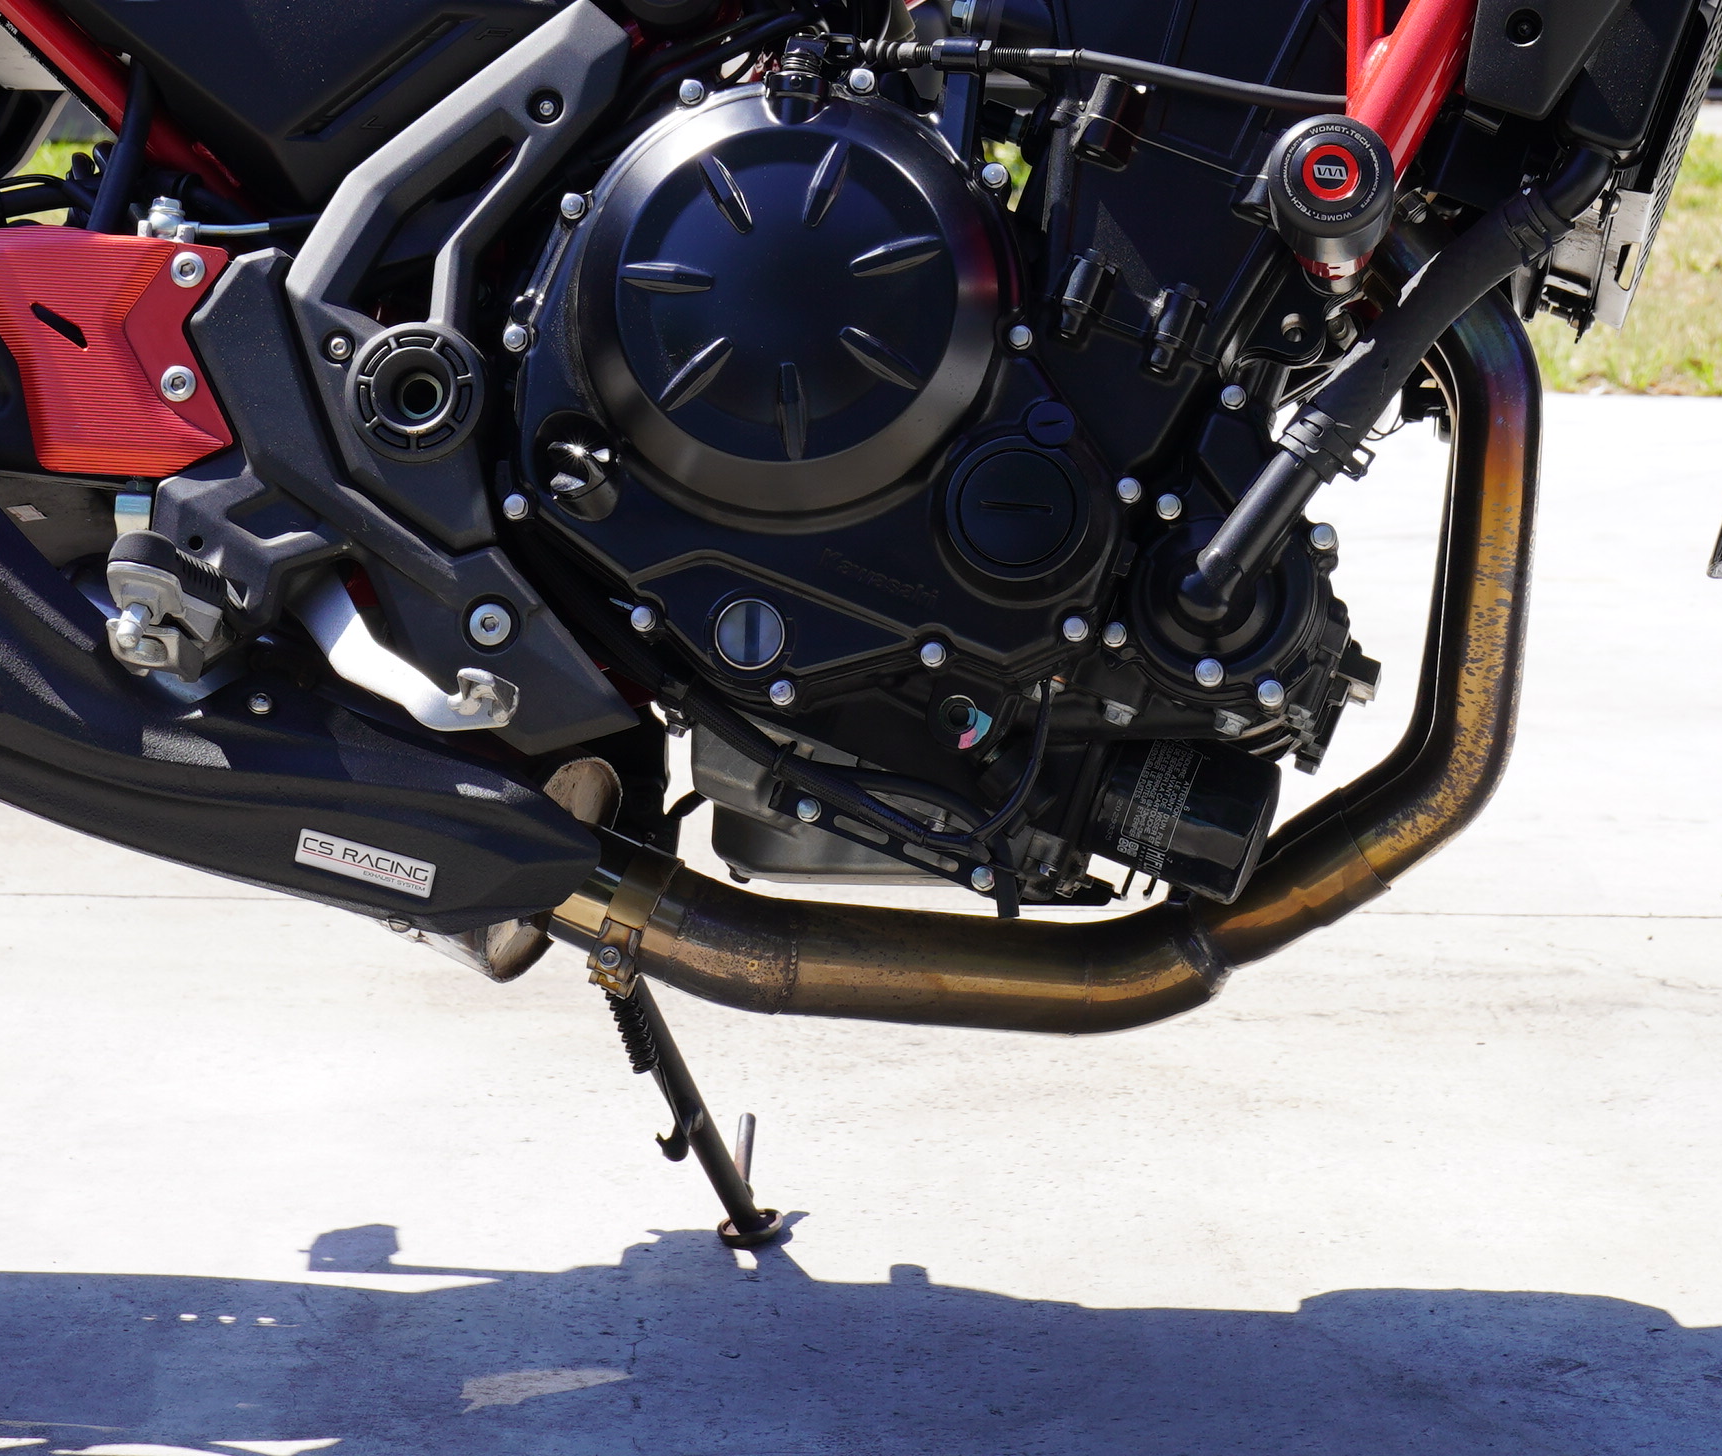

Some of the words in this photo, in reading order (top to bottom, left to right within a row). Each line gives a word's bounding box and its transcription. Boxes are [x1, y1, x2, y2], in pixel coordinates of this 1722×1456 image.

[818, 547, 940, 610] Kawasaki
[1162, 755, 1177, 783] SERRER
[1164, 774, 1177, 797] AVANT
[1171, 780, 1189, 818] ATTENTION
[1165, 789, 1178, 811] JOINT
[1149, 810, 1163, 836] VISSER
[302, 837, 334, 855] CS
[342, 847, 429, 882] RACING
[362, 870, 395, 883] EXHAUST
[396, 879, 426, 892] SYSTEM
